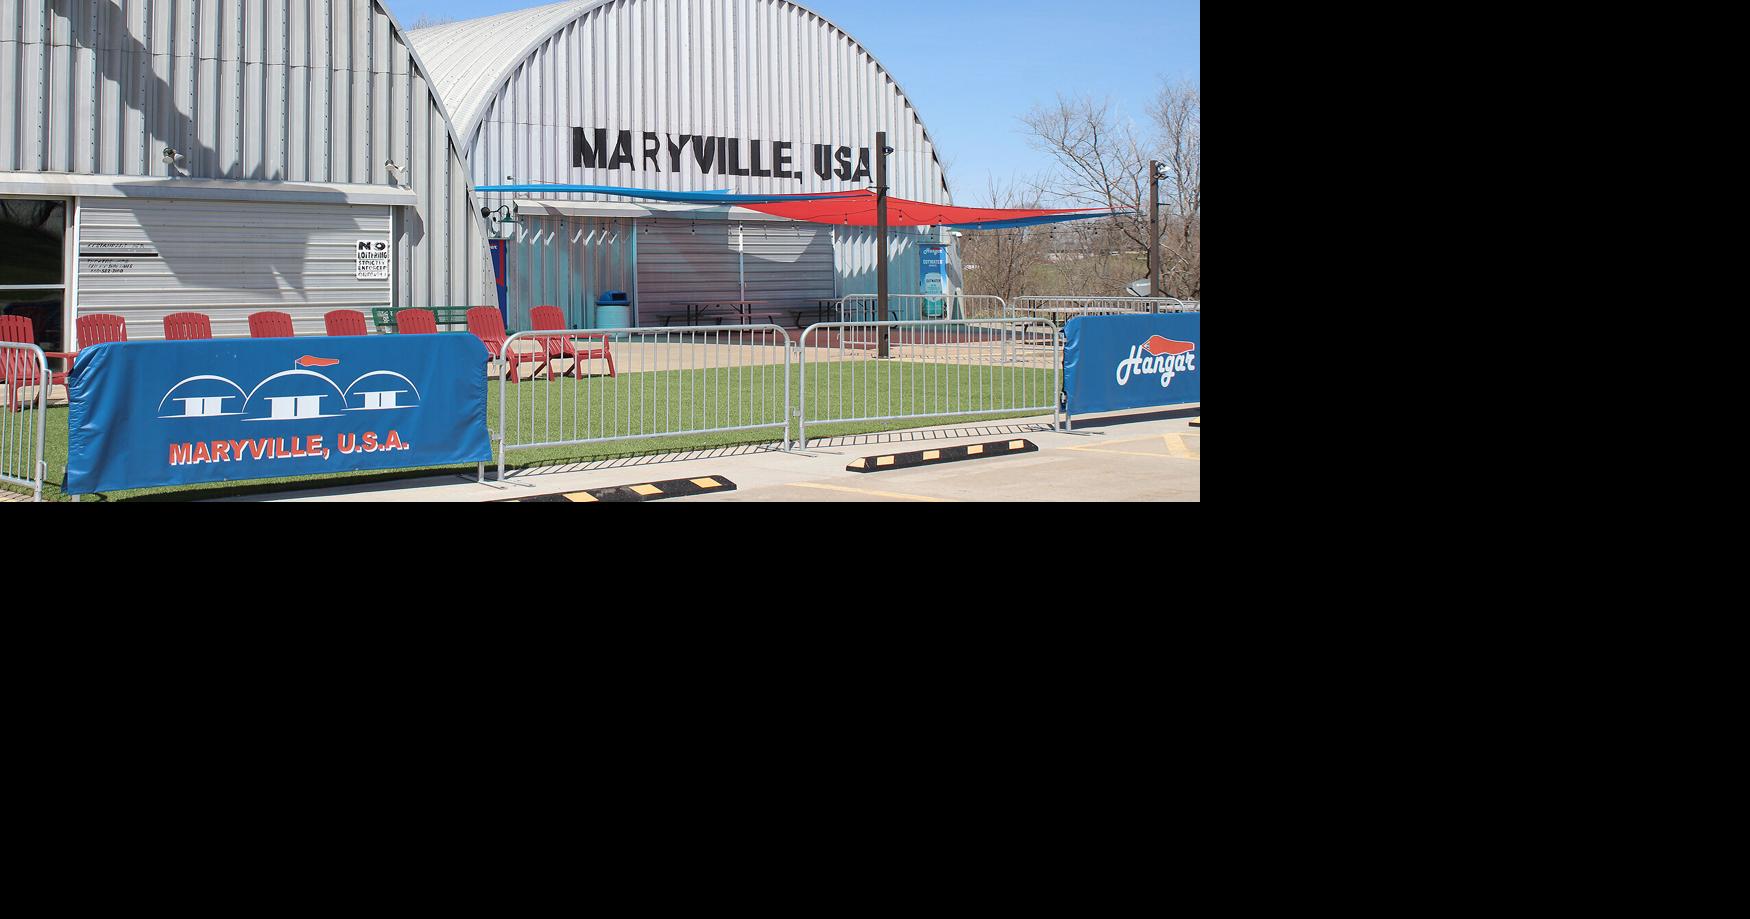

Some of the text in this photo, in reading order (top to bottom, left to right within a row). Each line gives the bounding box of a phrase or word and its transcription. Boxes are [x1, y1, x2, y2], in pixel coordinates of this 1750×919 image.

[572, 126, 873, 184] MARYVILLE, USA
[358, 241, 386, 251] NO
[1116, 345, 1195, 387] Hangar
[169, 429, 410, 466] MARYVILLE, U.S.A.
